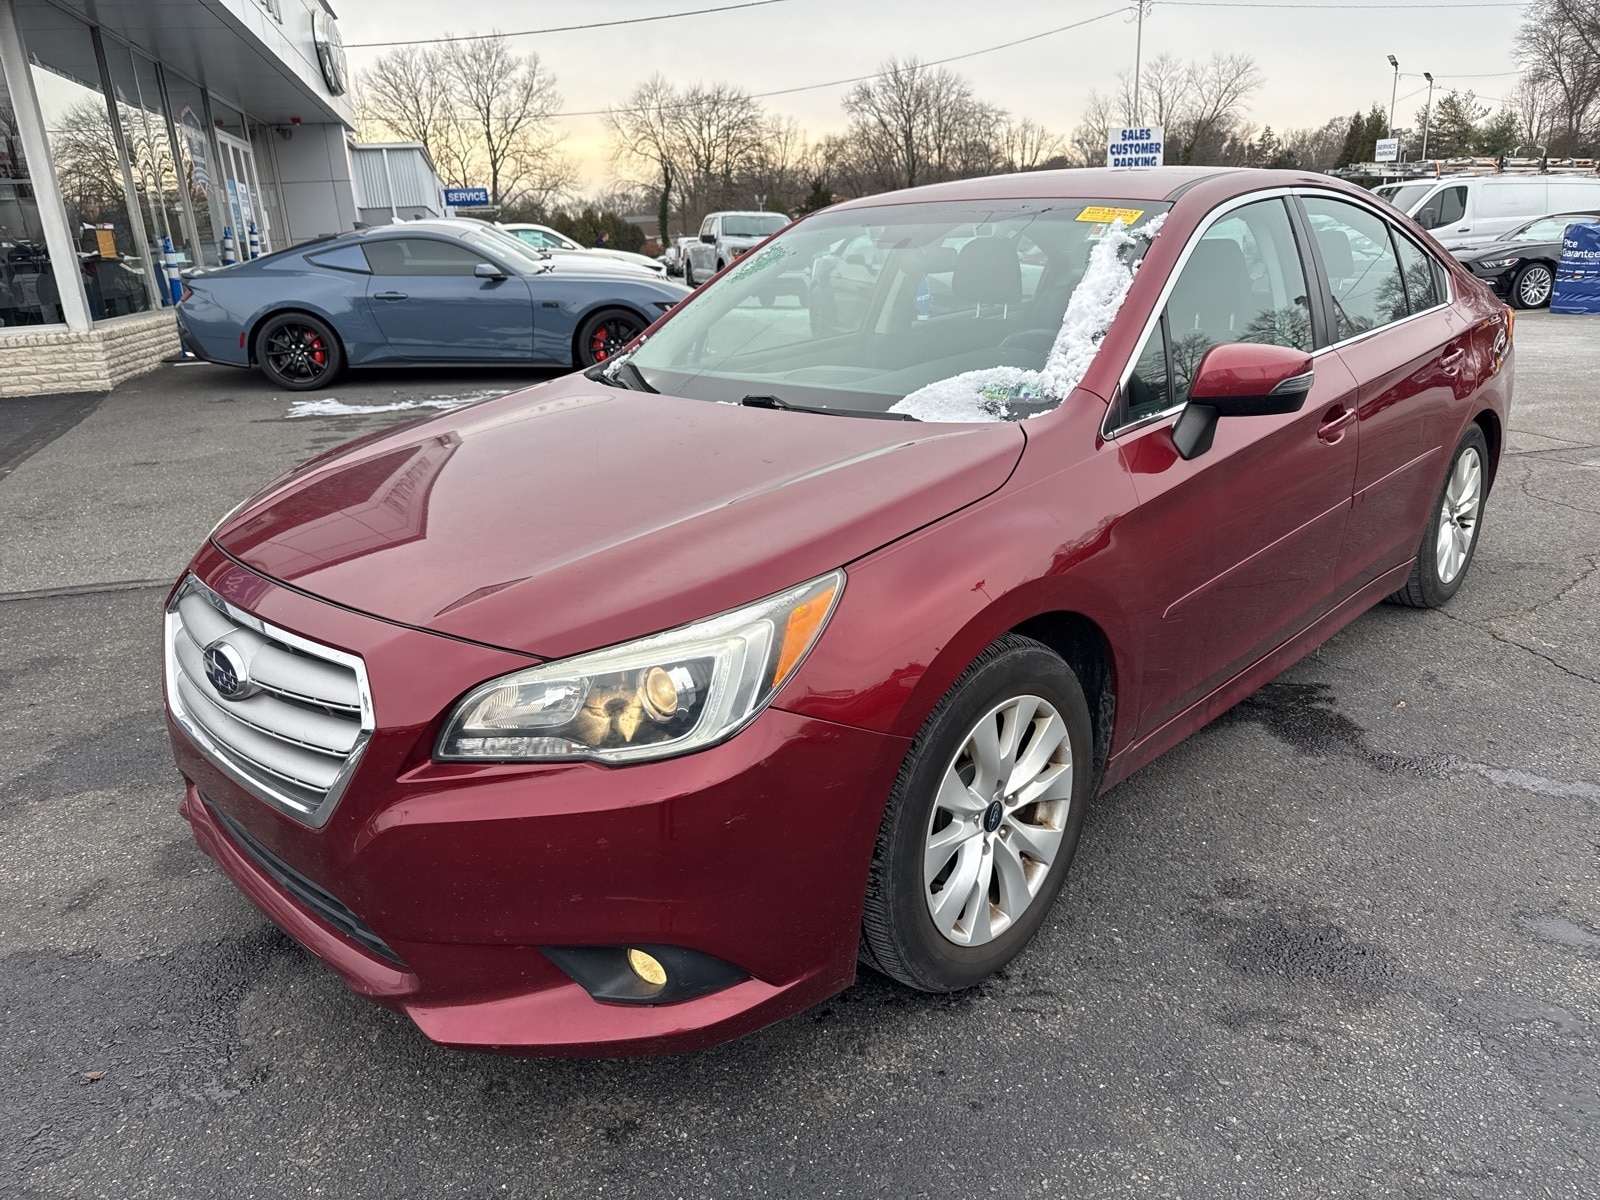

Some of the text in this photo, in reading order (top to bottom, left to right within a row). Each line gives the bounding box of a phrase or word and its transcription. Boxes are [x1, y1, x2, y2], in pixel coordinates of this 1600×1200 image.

[1121, 129, 1151, 141] SALES
[1110, 142, 1161, 155] CUSTOMER
[1113, 156, 1157, 167] PARKING
[447, 191, 487, 202] SERVICE
[1564, 239, 1578, 248] Pice
[1562, 248, 1600, 258] Garantee
